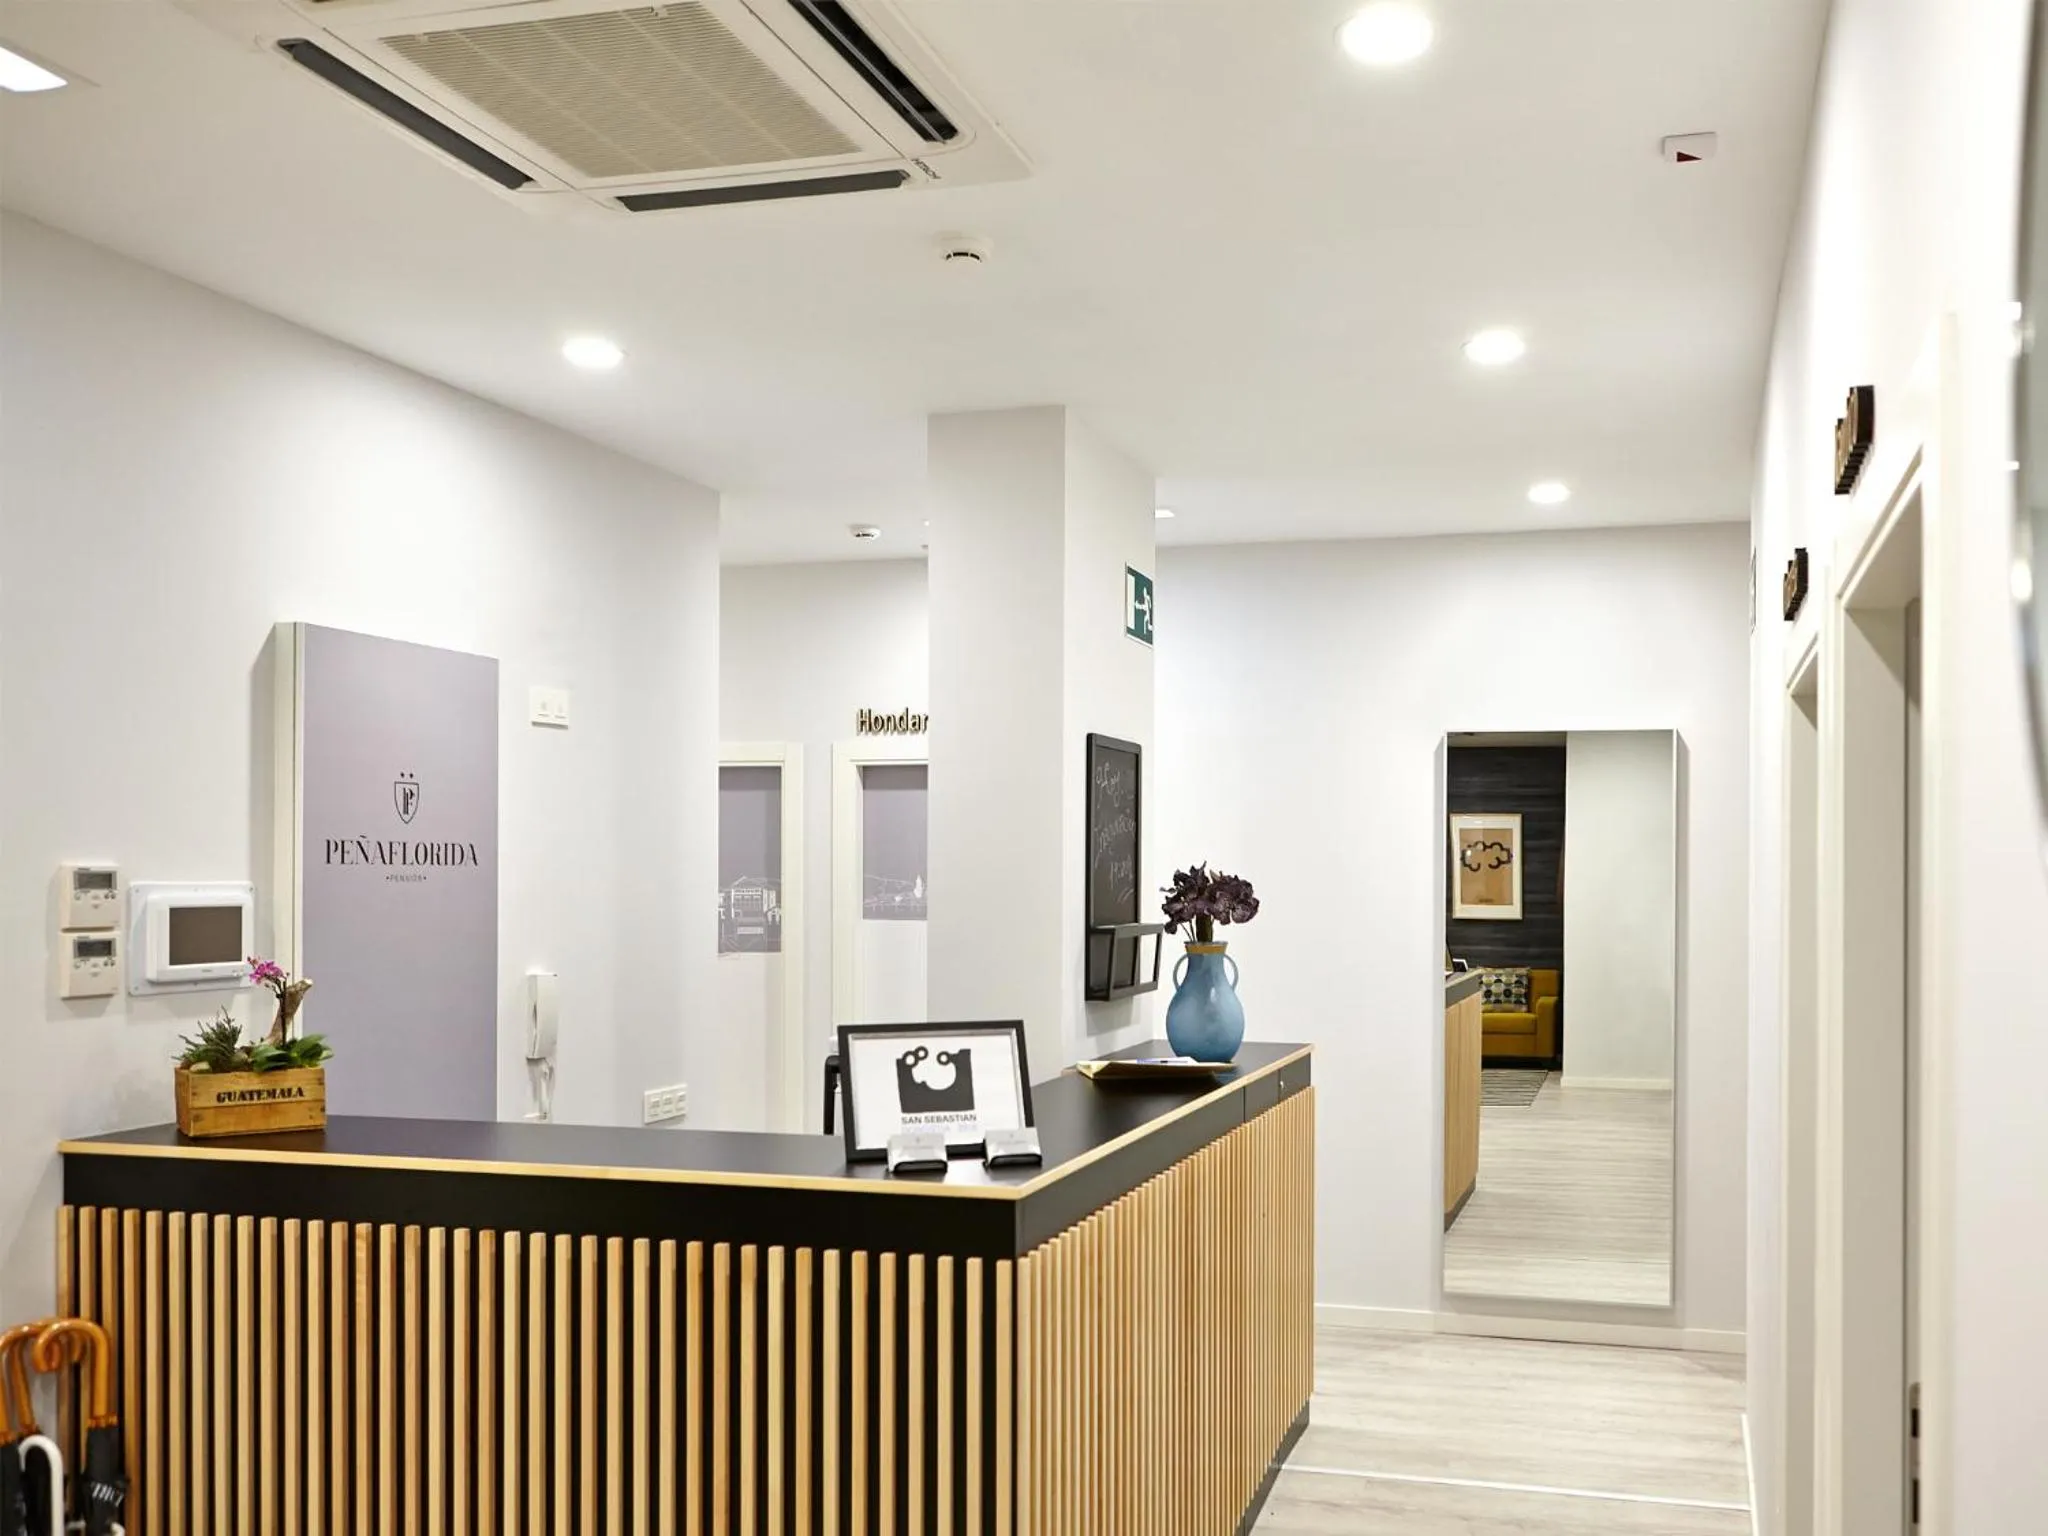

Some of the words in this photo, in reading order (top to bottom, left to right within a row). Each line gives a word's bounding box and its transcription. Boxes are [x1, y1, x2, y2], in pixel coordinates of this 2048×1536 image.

[325, 834, 479, 867] PEÑAFLORIDA
[216, 1086, 304, 1104] GUATEMALA
[901, 1115, 923, 1125] SAN
[924, 1113, 977, 1124] SEBASTIAN
